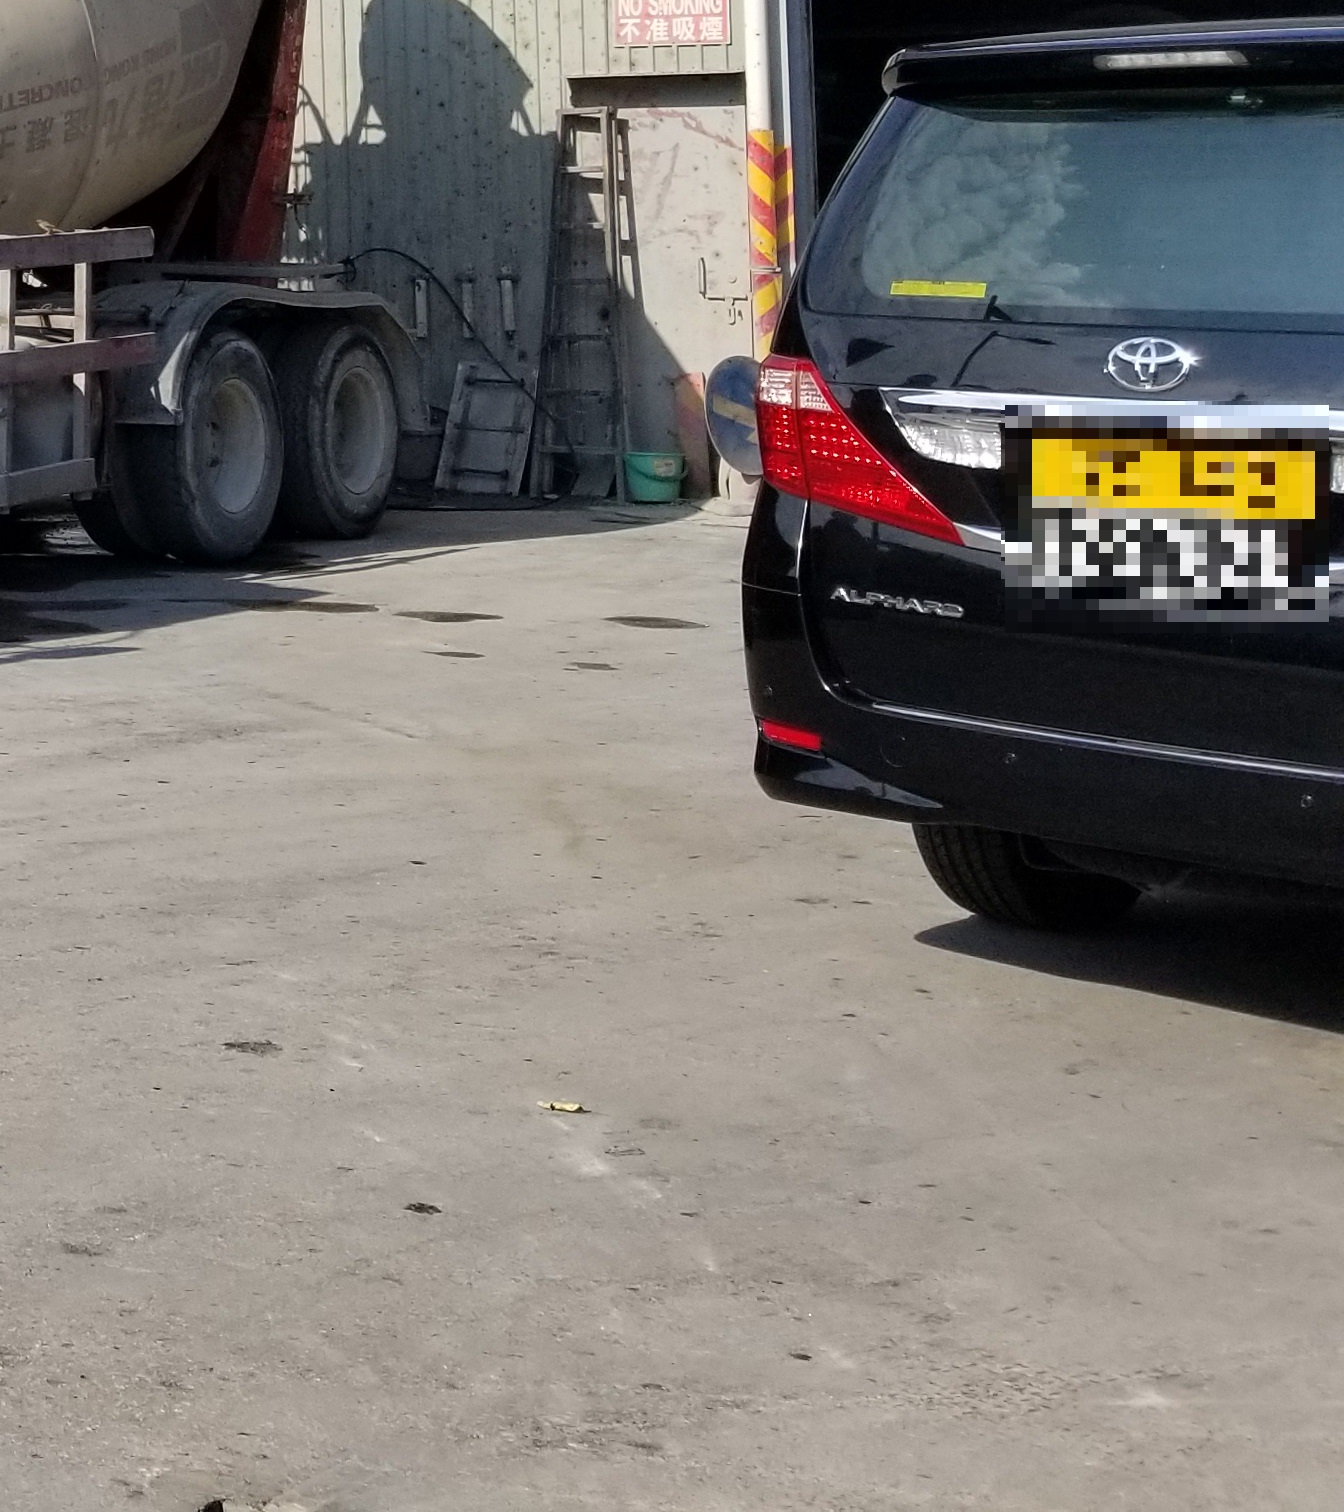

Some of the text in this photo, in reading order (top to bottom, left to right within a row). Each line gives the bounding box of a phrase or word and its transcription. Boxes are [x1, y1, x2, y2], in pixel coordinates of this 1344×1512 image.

[619, 17, 724, 43] 不准吸煙
[830, 586, 965, 619] ALPHARD
